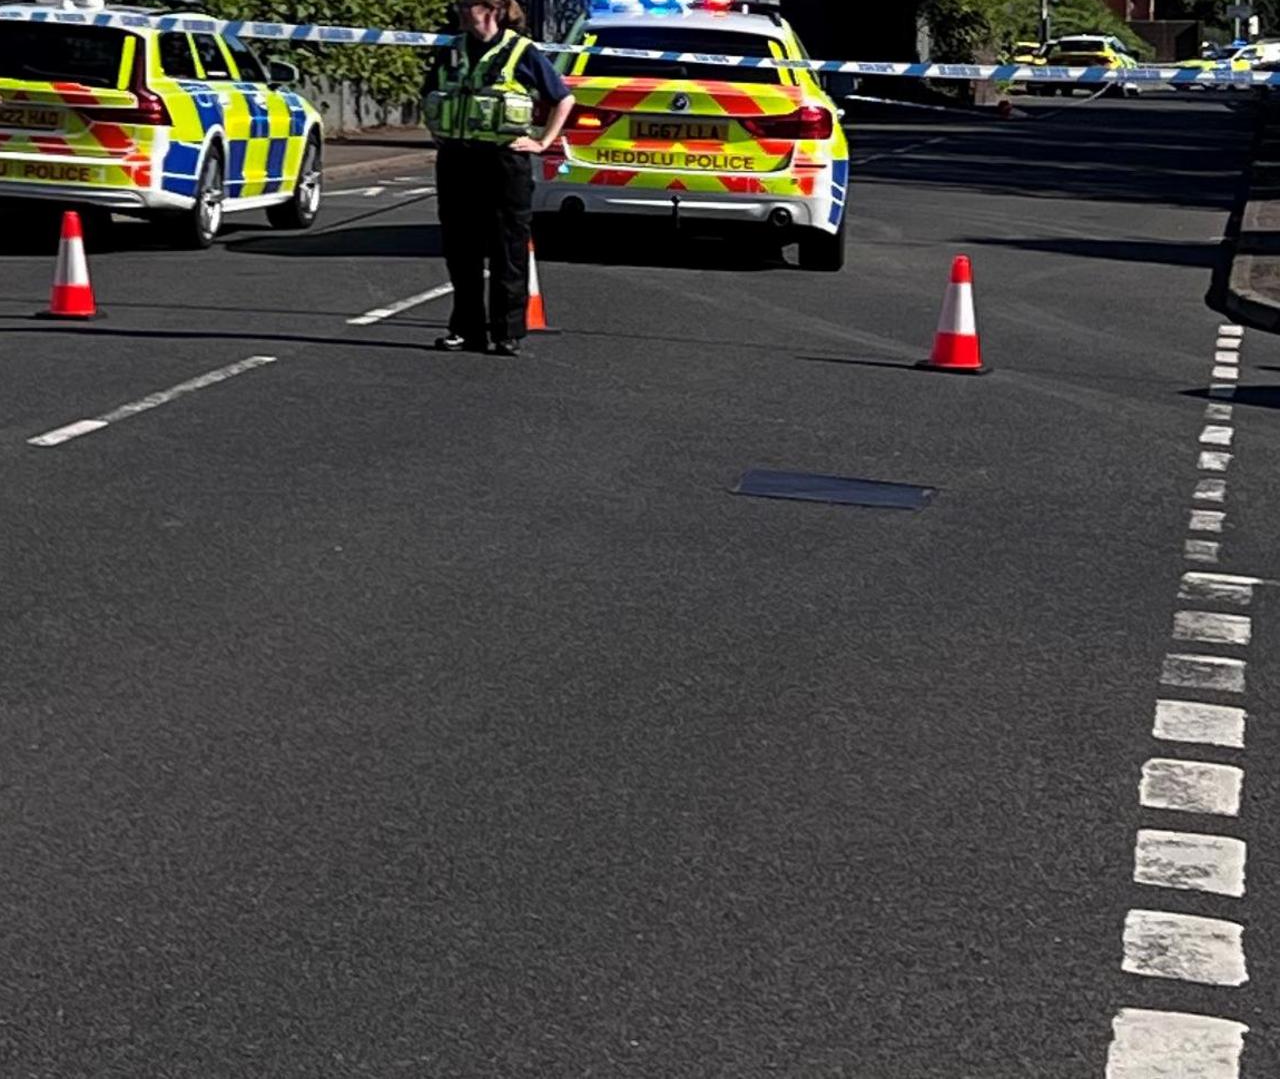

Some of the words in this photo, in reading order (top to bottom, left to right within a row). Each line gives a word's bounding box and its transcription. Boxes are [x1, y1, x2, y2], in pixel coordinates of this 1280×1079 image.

[597, 150, 674, 166] HEDDLU
[684, 154, 755, 170] POLICE
[23, 163, 91, 182] POLICE
